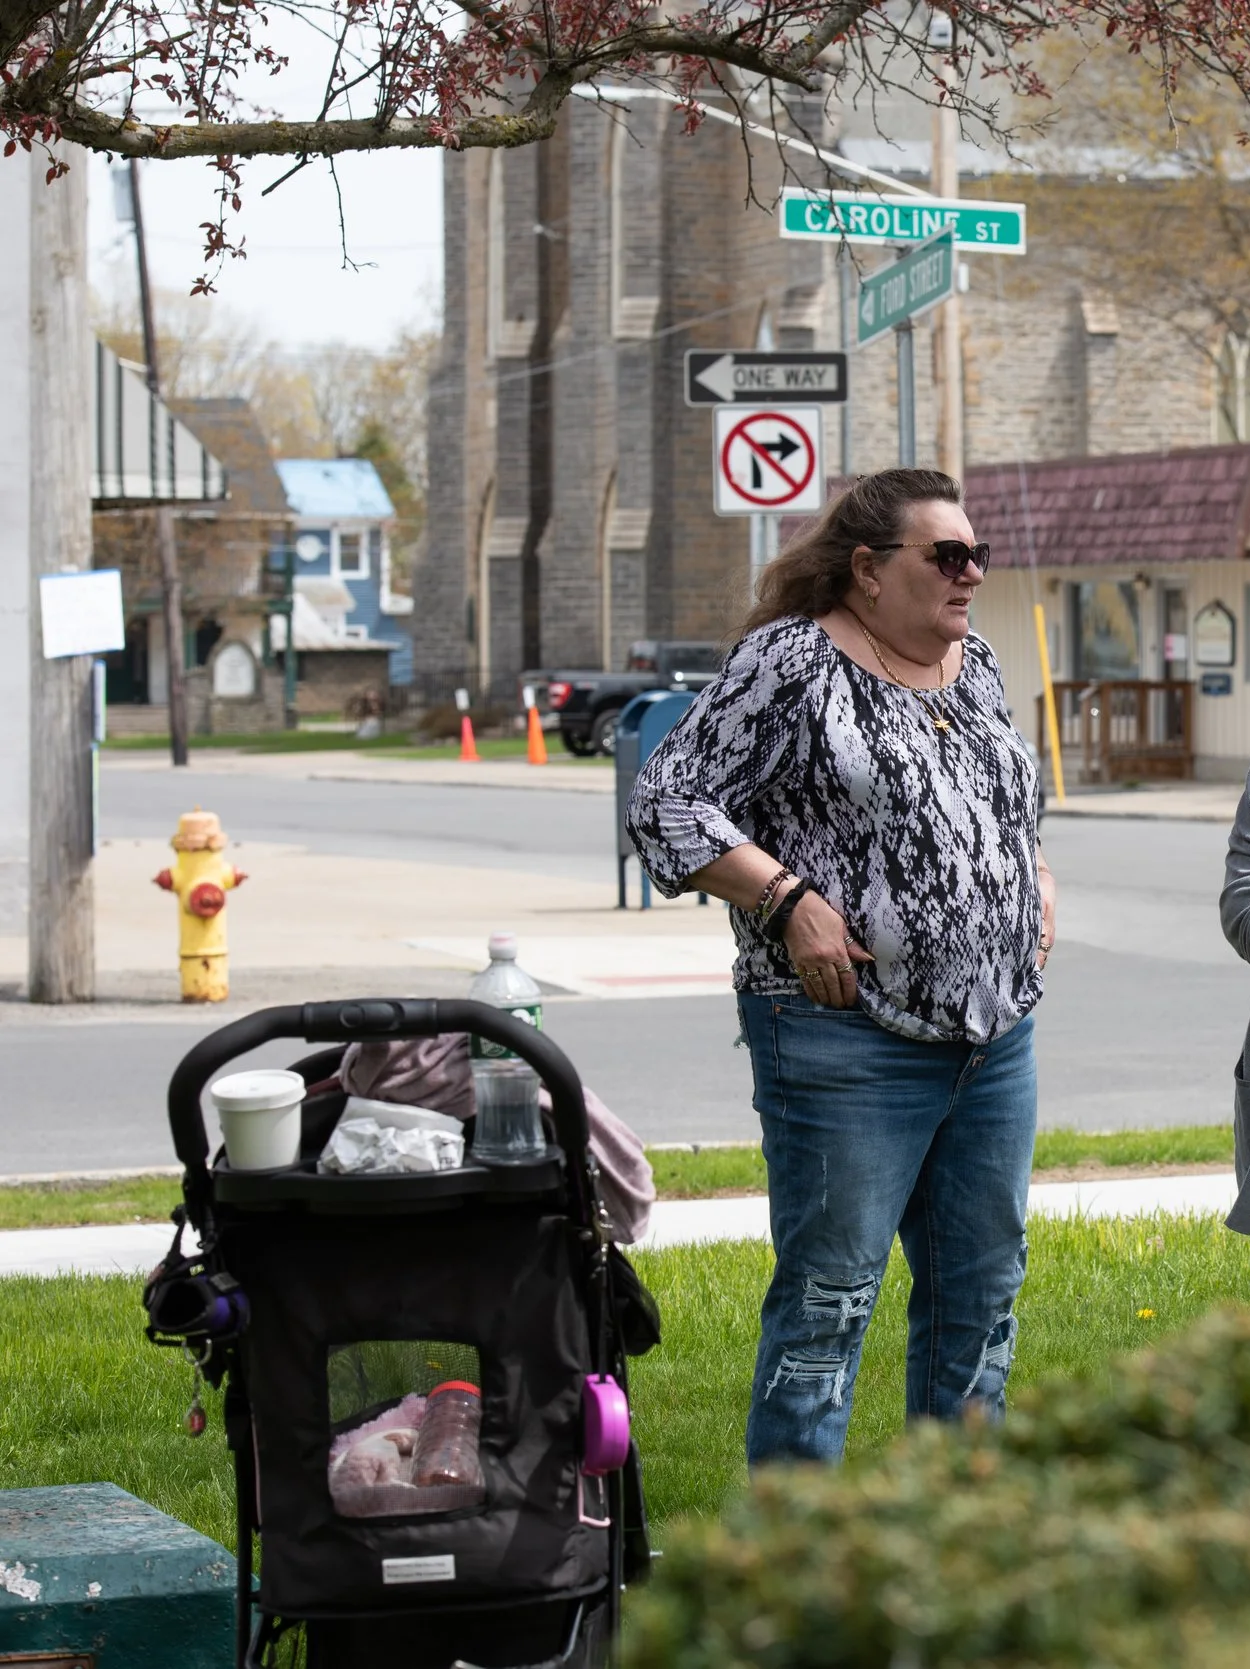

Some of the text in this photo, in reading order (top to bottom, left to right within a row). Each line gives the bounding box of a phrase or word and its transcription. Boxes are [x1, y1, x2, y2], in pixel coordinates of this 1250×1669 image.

[804, 201, 1002, 241] CAROLINE ST
[909, 248, 945, 302] STREET
[733, 367, 827, 387] ONE WAY
